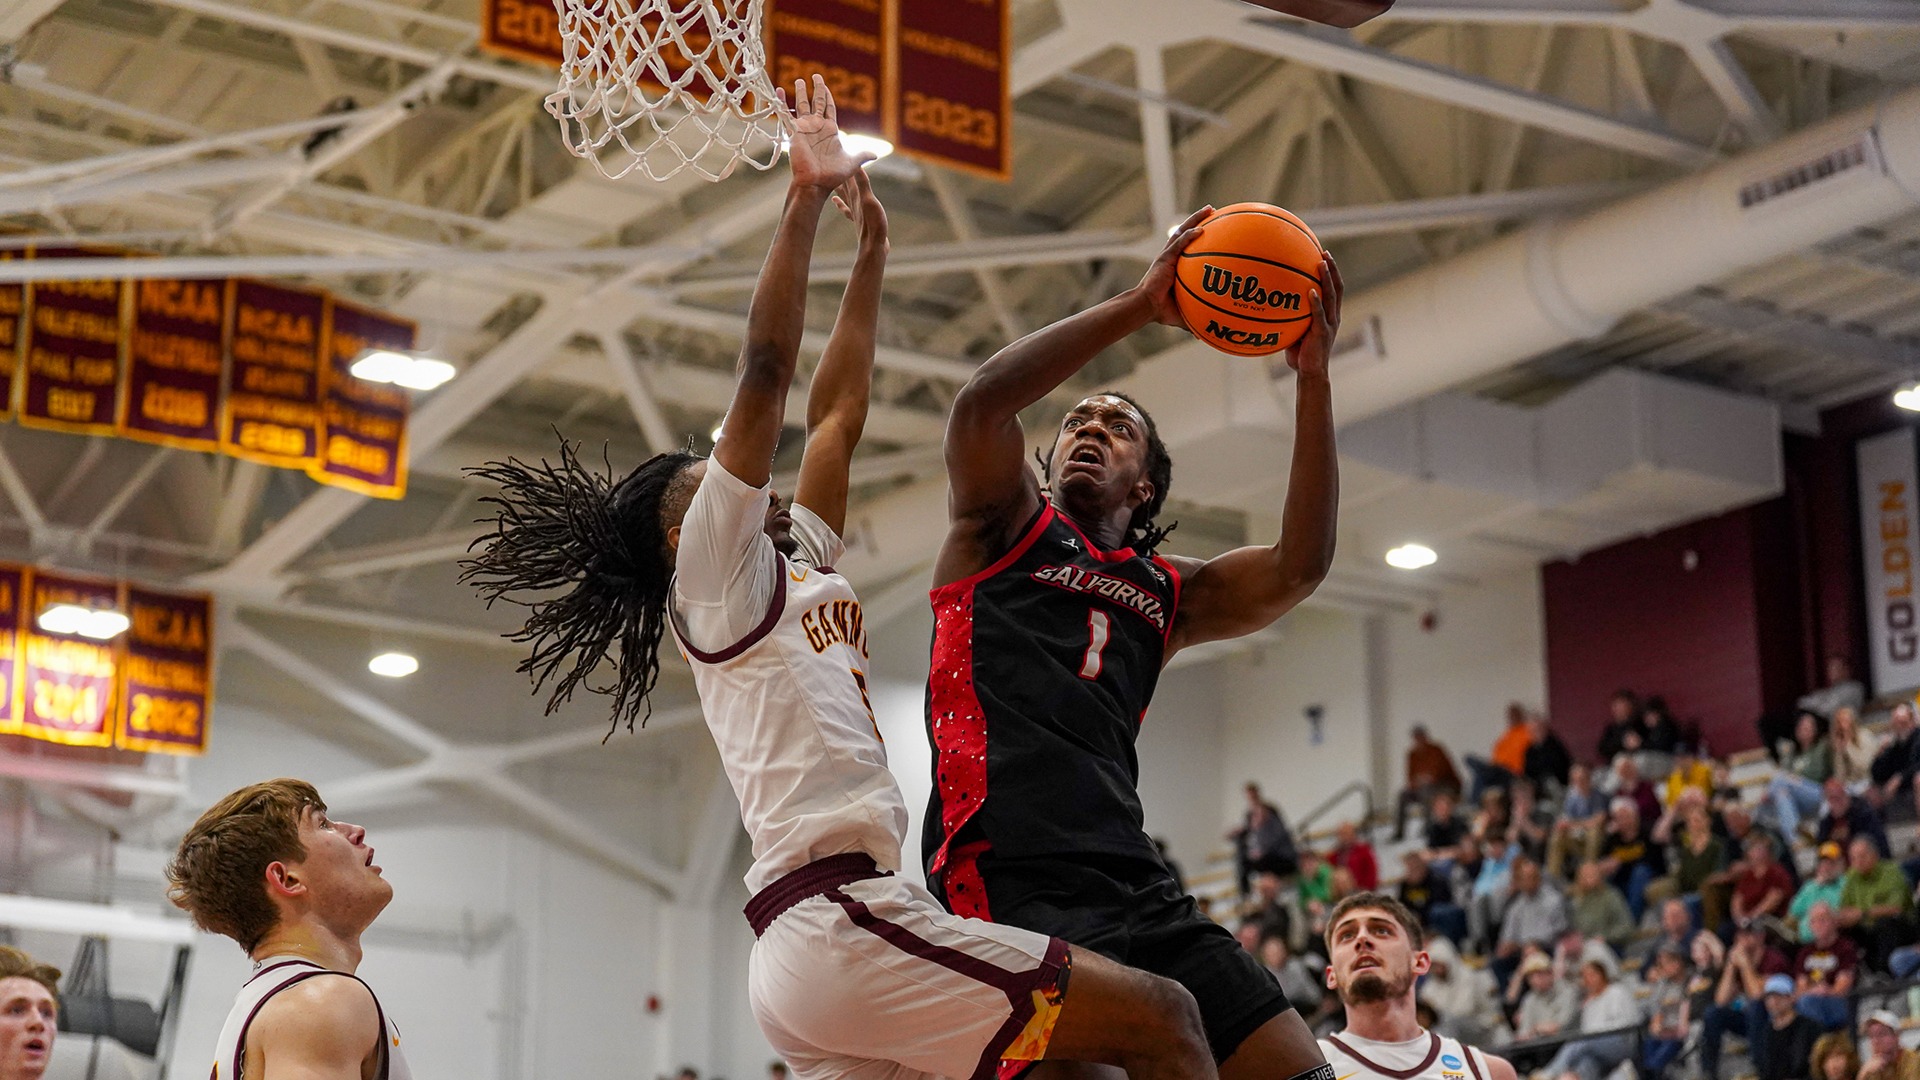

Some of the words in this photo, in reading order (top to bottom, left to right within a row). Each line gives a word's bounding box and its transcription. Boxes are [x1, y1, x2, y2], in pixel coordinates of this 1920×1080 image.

[904, 90, 997, 147] 2023
[1202, 264, 1301, 311] Wilson
[1205, 319, 1280, 347] NCAA
[1033, 565, 1166, 632] CALIFORNIA
[1878, 480, 1918, 663] GOLDEN
[1079, 607, 1111, 681] 1
